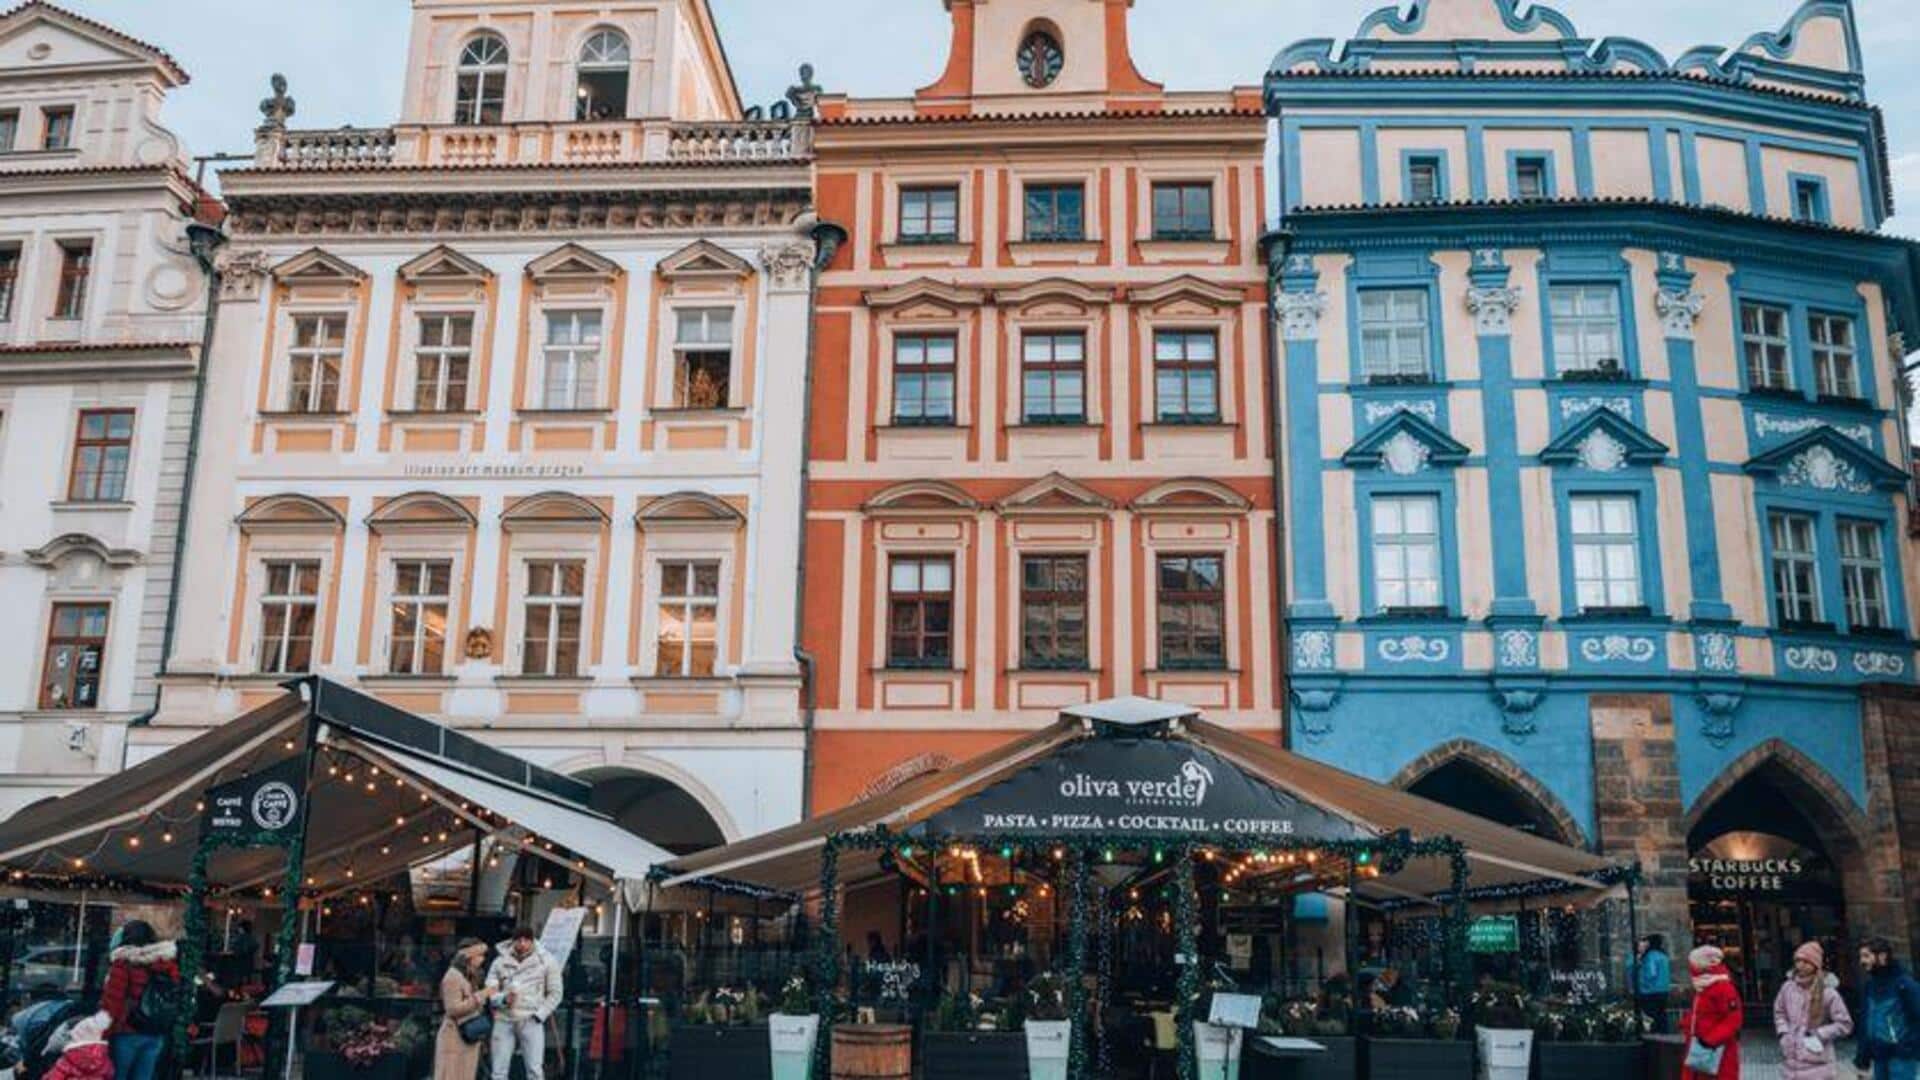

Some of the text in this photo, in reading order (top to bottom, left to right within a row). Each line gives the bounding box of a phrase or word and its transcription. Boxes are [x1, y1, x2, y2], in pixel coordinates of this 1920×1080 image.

[1060, 773, 1196, 799] oliva verde
[983, 814, 1294, 835] PASTA PIZZA COCKTAIL COFFEE
[1688, 857, 1801, 873] STARBUCKS
[1711, 874, 1783, 889] COFFEE
